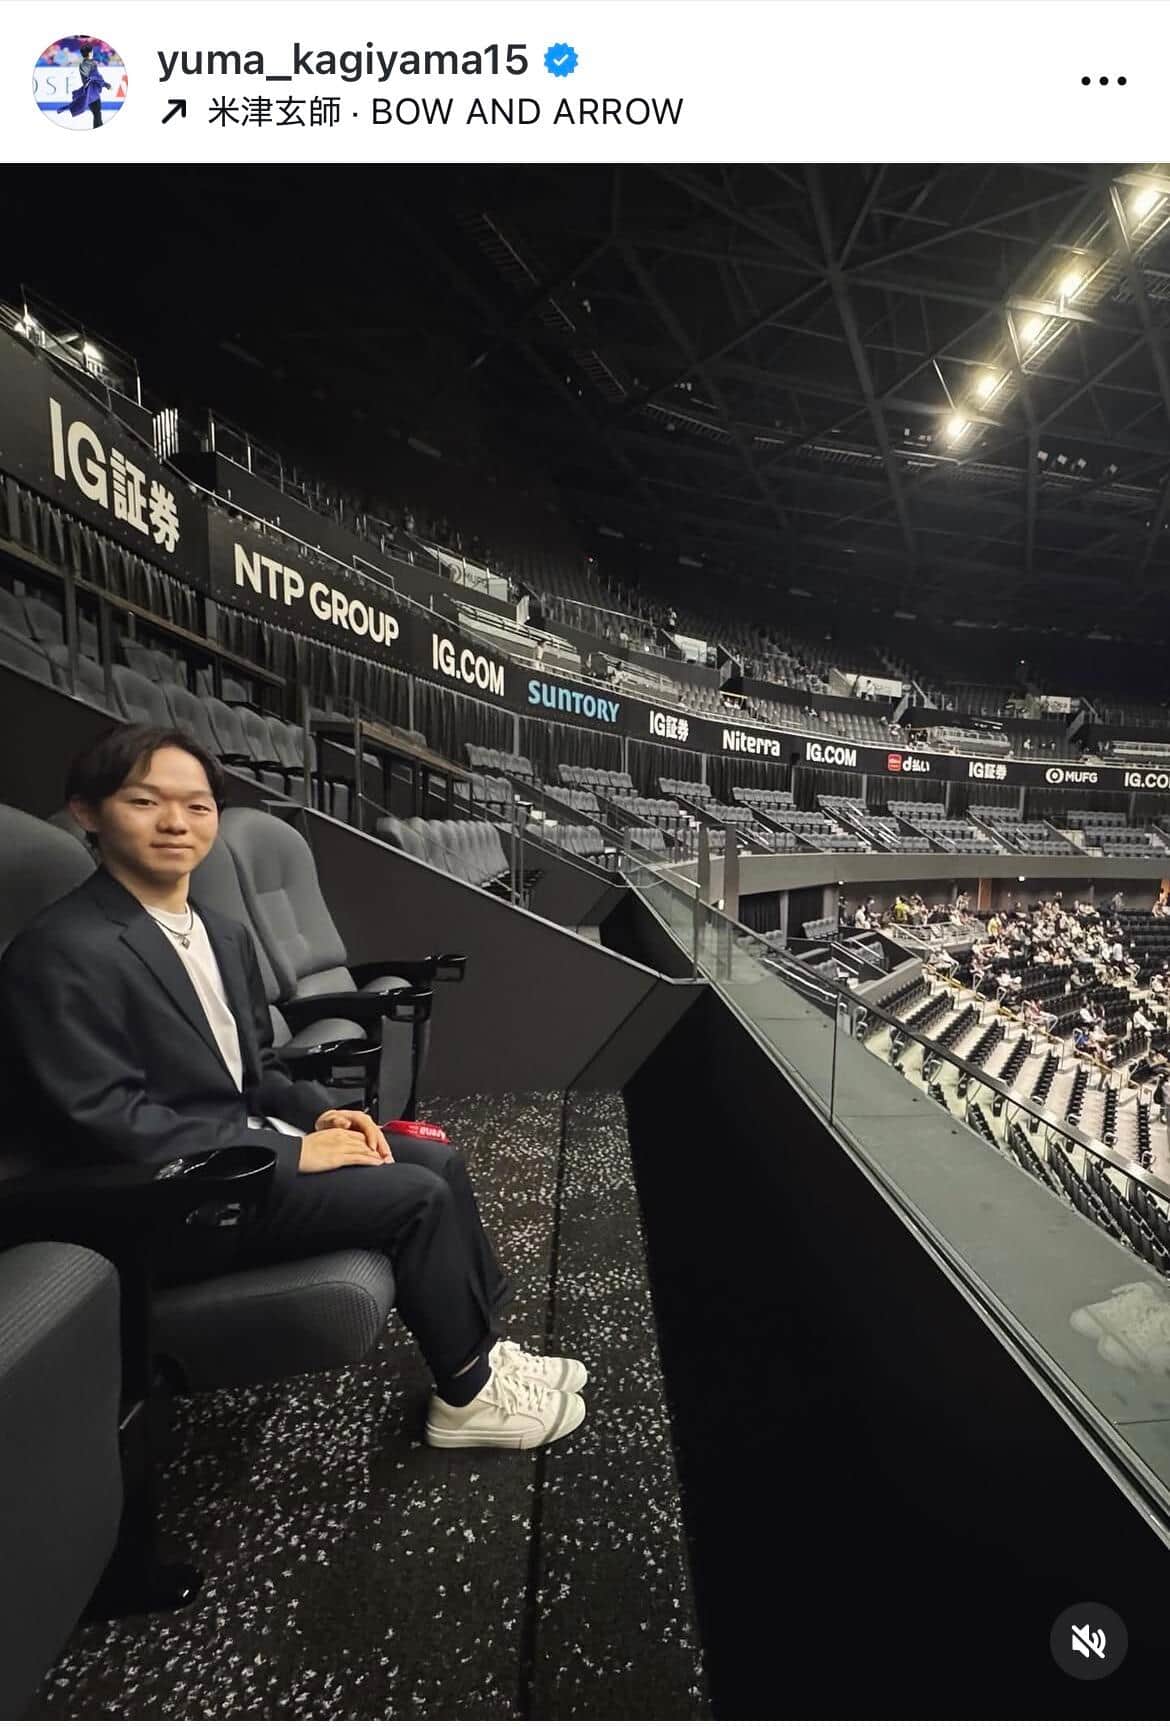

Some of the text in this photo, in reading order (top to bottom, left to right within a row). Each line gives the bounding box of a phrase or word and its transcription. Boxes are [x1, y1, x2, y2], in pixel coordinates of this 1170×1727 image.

[49, 397, 180, 554] IG証券
[233, 543, 400, 648] NTP GROUP
[431, 634, 505, 697] IG.COM
[527, 679, 620, 723] SUNTORY
[648, 709, 690, 743] IG証券
[722, 729, 781, 758] Niterra
[805, 742, 857, 768] IG.COM
[968, 761, 1008, 781] IG証券
[1064, 770, 1099, 784] MUFG
[1124, 771, 1170, 790] IG.CO
